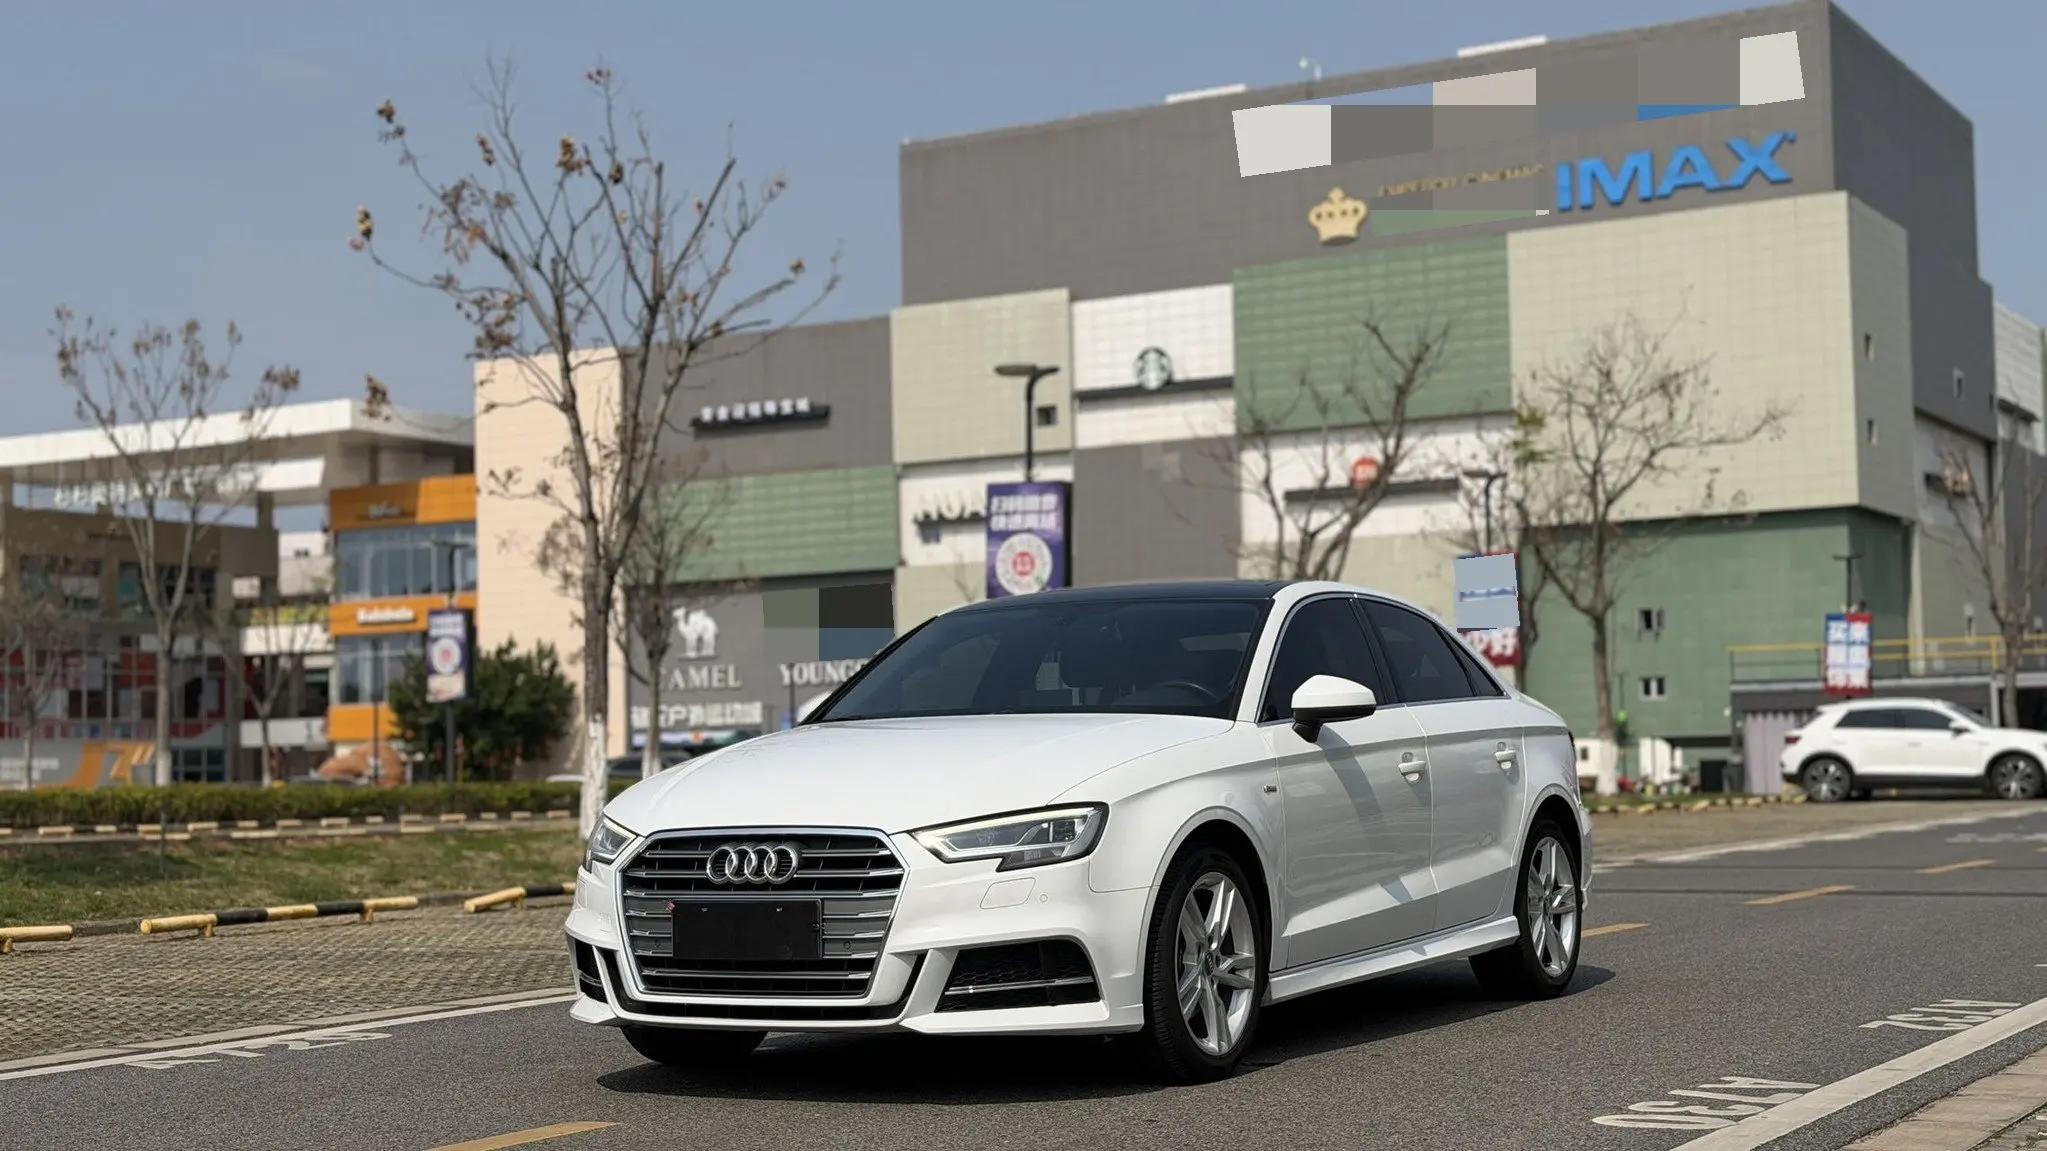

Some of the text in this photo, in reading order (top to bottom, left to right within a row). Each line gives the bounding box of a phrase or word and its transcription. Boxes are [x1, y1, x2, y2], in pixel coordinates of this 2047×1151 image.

[1556, 131, 1796, 212] IMAX
[658, 664, 743, 691] AMEL
[1858, 998, 2022, 1031] A132
[1591, 1075, 1821, 1131] A130
